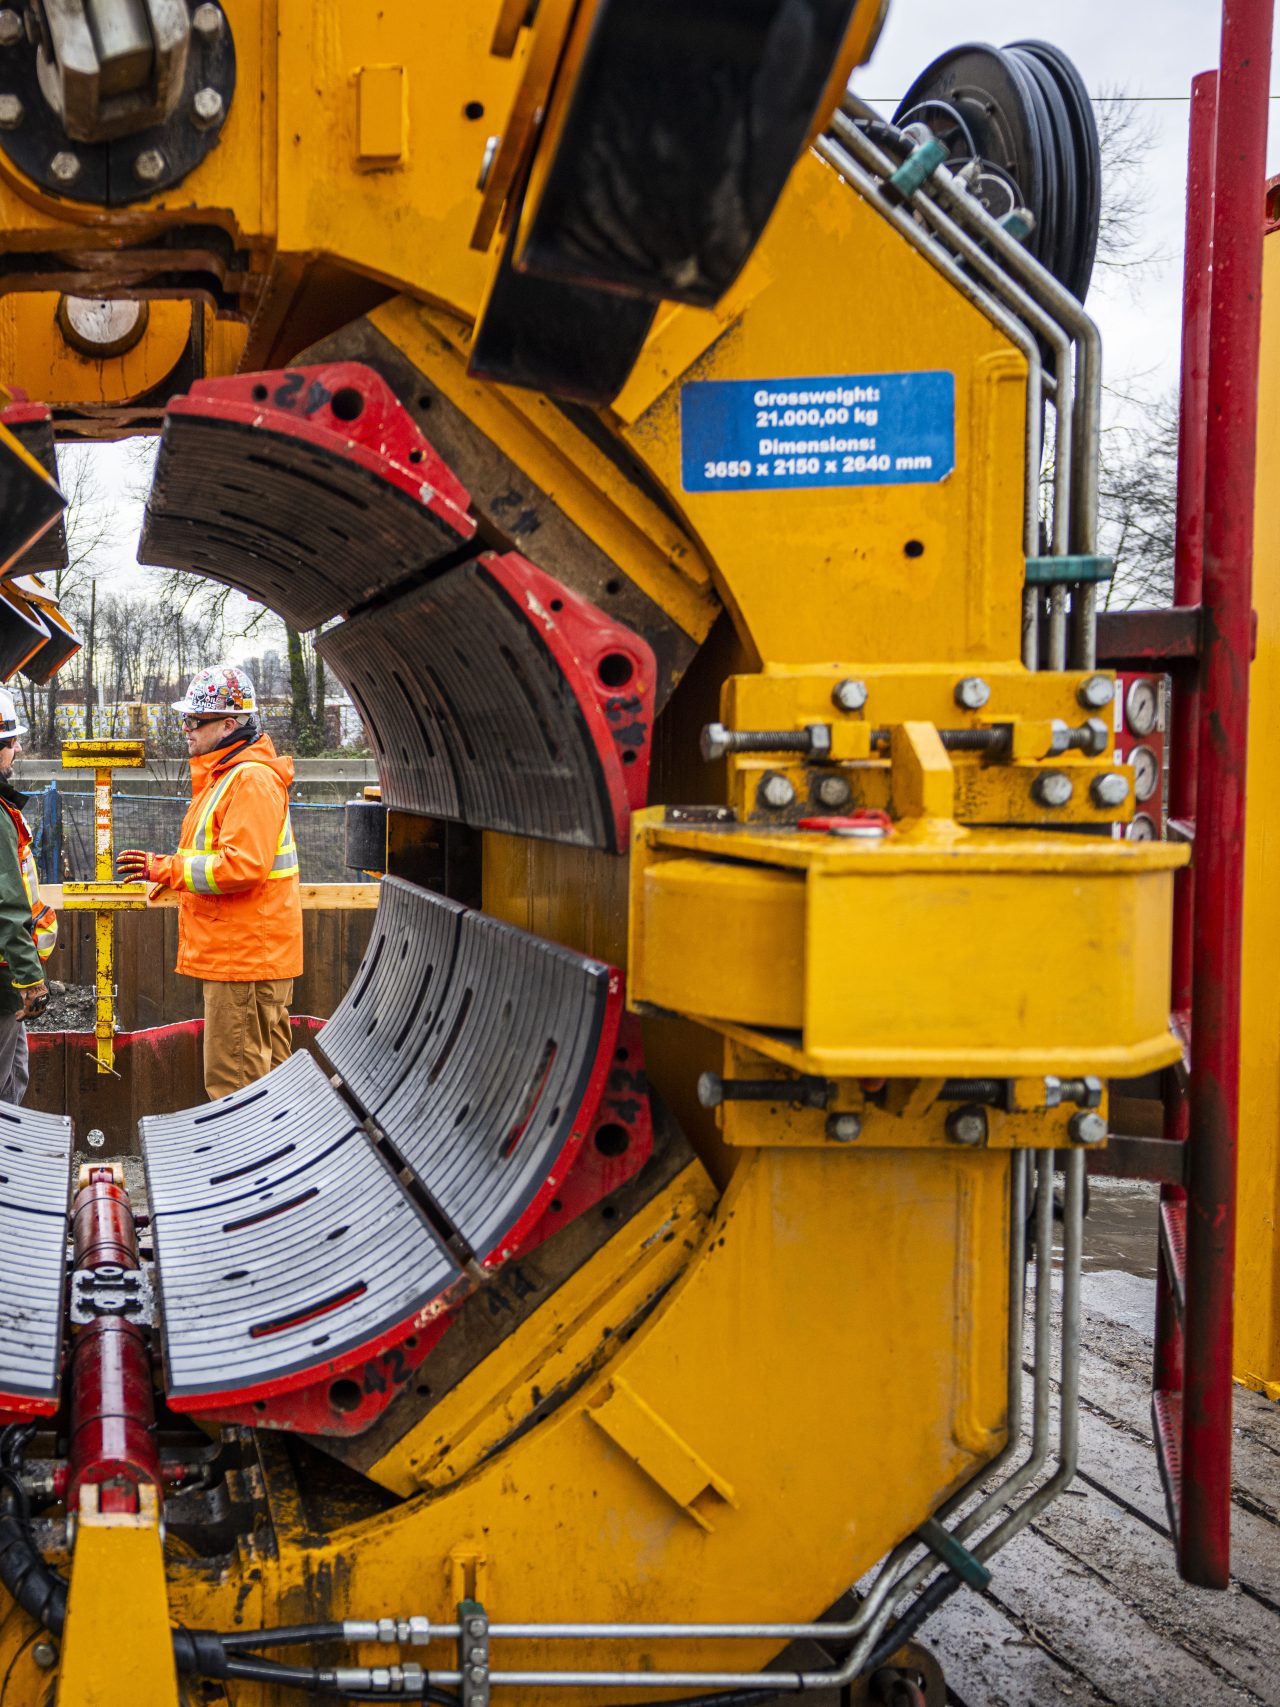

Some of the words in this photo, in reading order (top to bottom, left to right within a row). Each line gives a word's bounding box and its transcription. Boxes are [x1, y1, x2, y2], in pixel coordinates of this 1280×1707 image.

[753, 386, 880, 407] Grossweight:
[756, 407, 849, 428] 21.000,00
[854, 407, 878, 426] kg
[759, 436, 876, 455] Dimensions:
[704, 460, 751, 478] 3650
[756, 463, 769, 476] x
[774, 457, 820, 476] 2150
[824, 460, 838, 474] x
[842, 454, 891, 473] 2640
[895, 456, 932, 471] mm
[363, 1348, 414, 1395] 42
